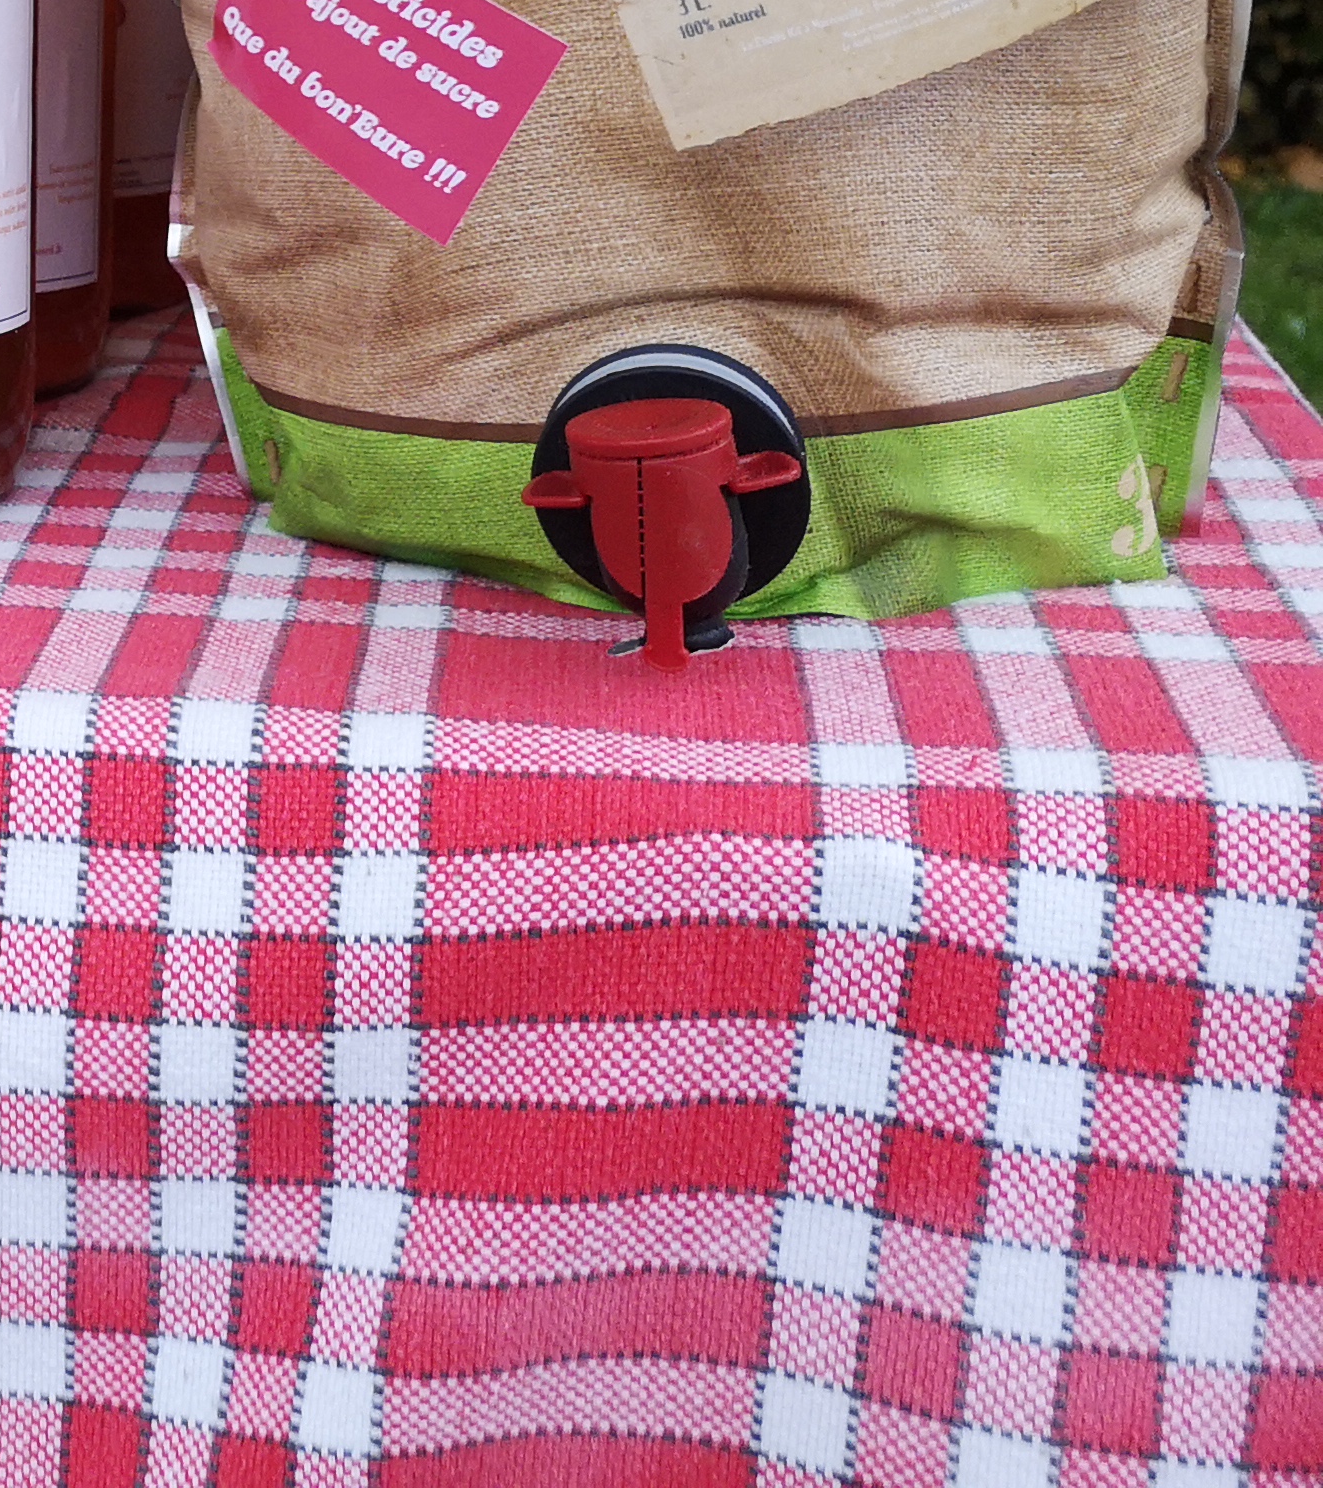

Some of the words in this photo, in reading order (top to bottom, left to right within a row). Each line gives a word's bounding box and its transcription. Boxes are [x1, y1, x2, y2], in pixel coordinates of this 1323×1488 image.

[679, 17, 715, 39] 100%
[718, 2, 767, 29] naturel
[222, 6, 265, 55] Que
[263, 46, 302, 86] du
[300, 71, 426, 170] bon'Eure
[377, 37, 418, 70] de
[415, 61, 501, 120] sucre
